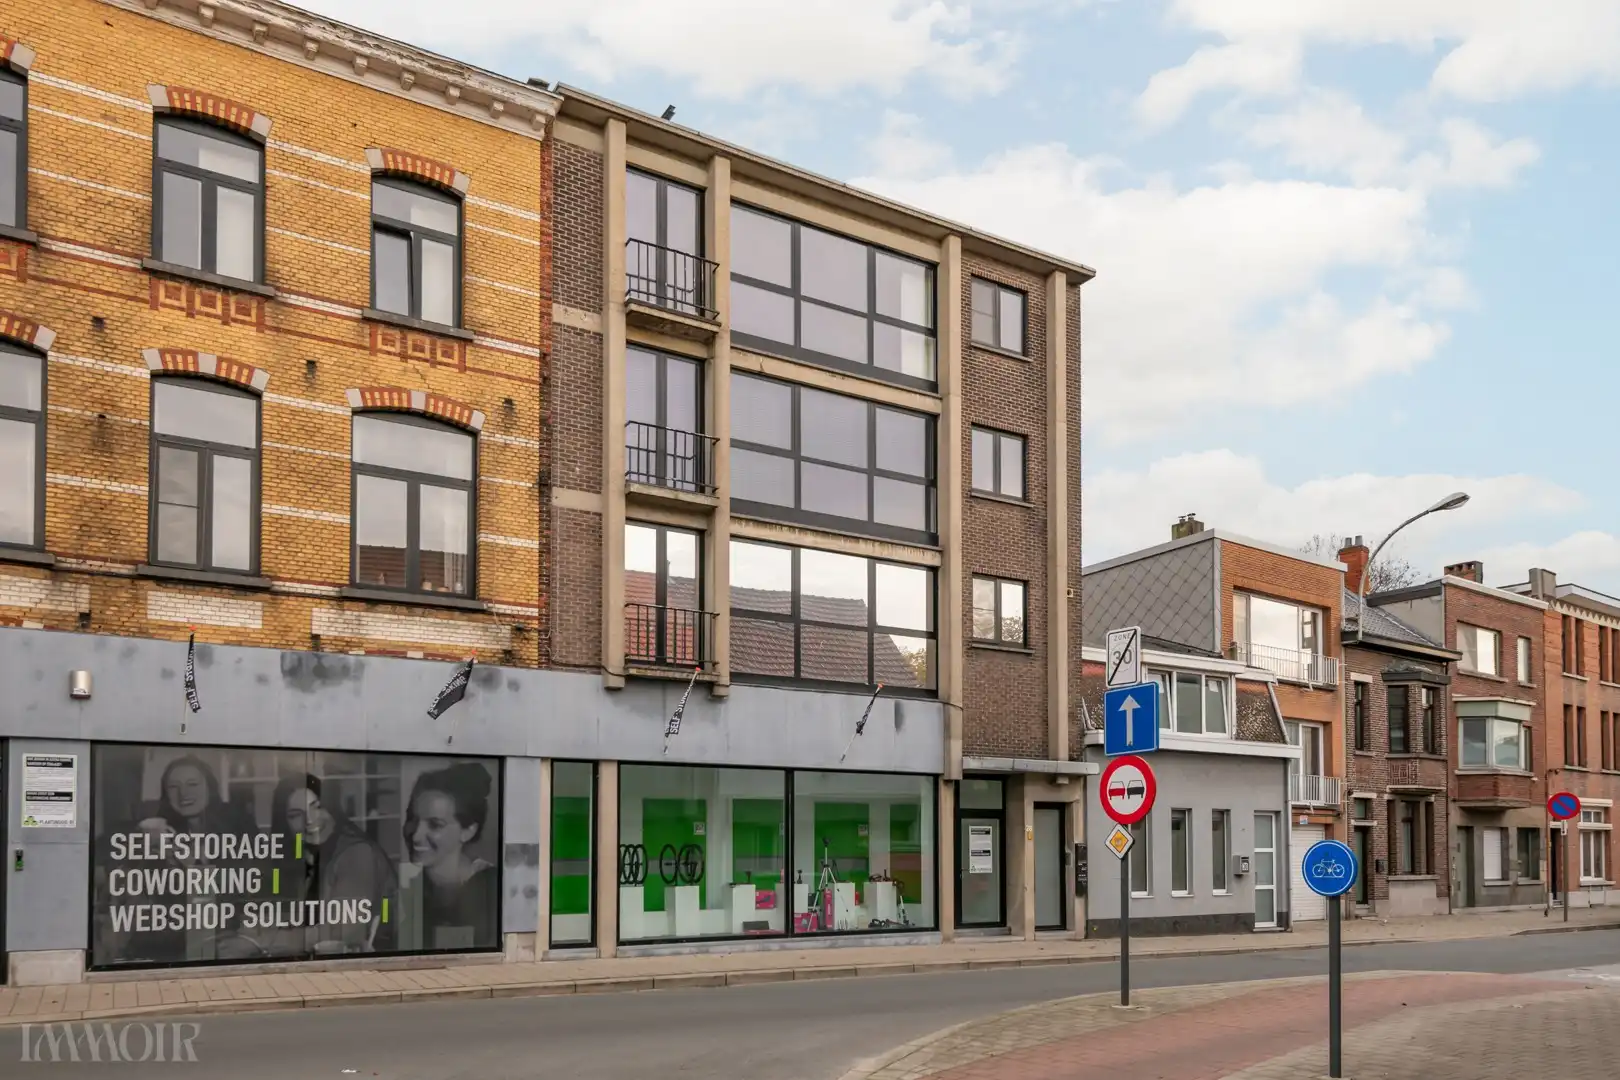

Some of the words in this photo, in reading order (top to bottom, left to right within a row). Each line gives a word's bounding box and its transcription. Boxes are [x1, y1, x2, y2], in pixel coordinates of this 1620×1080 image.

[1113, 632, 1132, 642] ZONE
[1112, 648, 1132, 666] 30
[109, 832, 285, 861] SELFSTORAGE
[109, 867, 262, 896] COWORKING
[109, 902, 236, 933] WEBSHOP
[242, 899, 372, 929] SOLUTIONS
